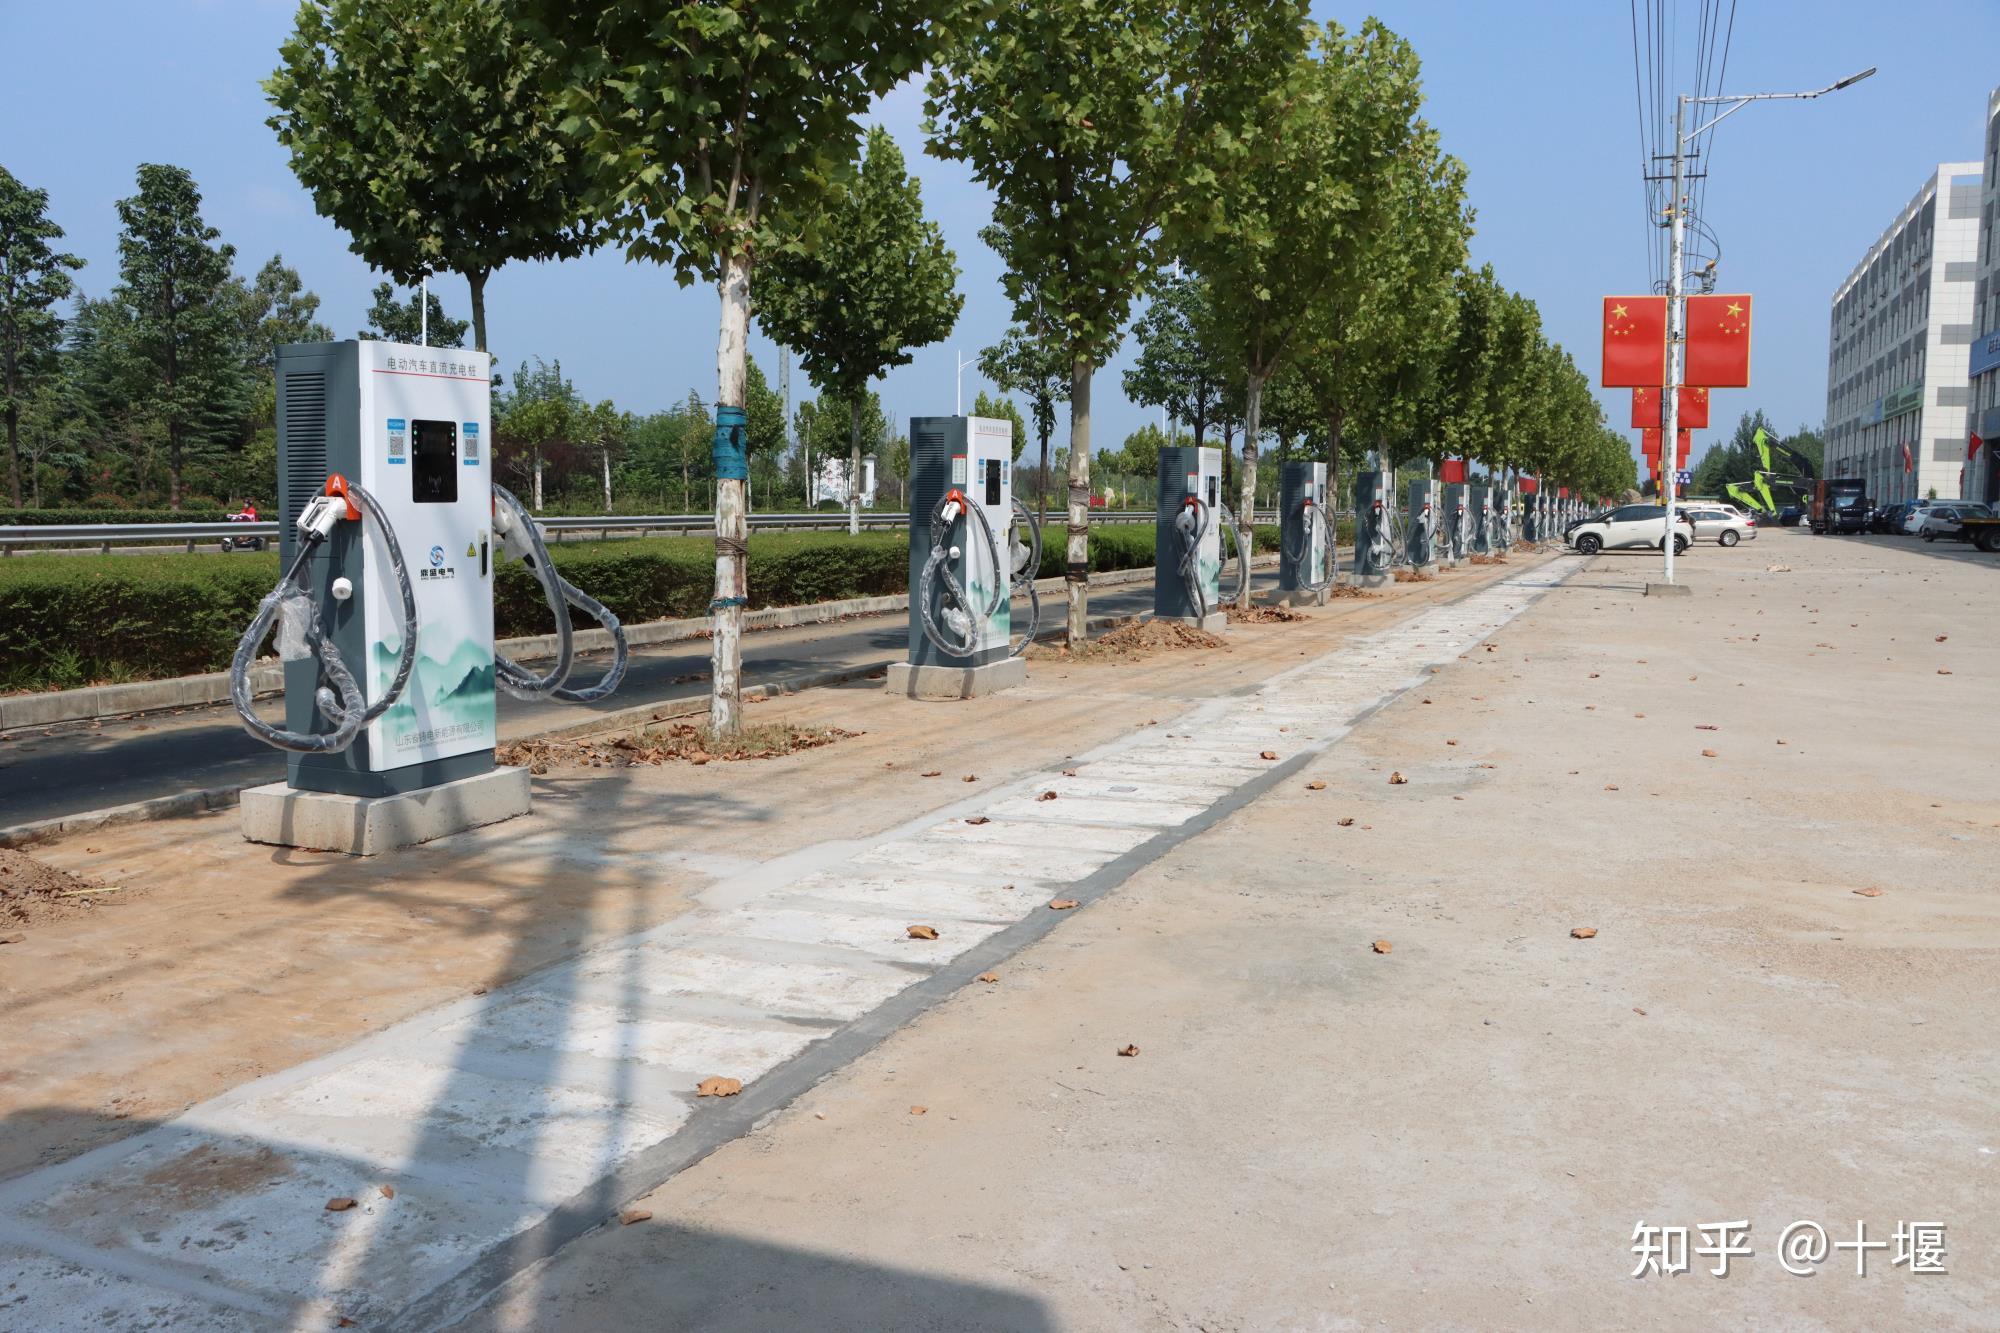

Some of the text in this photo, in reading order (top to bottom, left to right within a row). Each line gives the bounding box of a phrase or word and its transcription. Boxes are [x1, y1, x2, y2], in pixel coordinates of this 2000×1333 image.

[387, 356, 477, 377] 电动汽车直流充电桩
[332, 475, 342, 489] A
[952, 490, 959, 499] A
